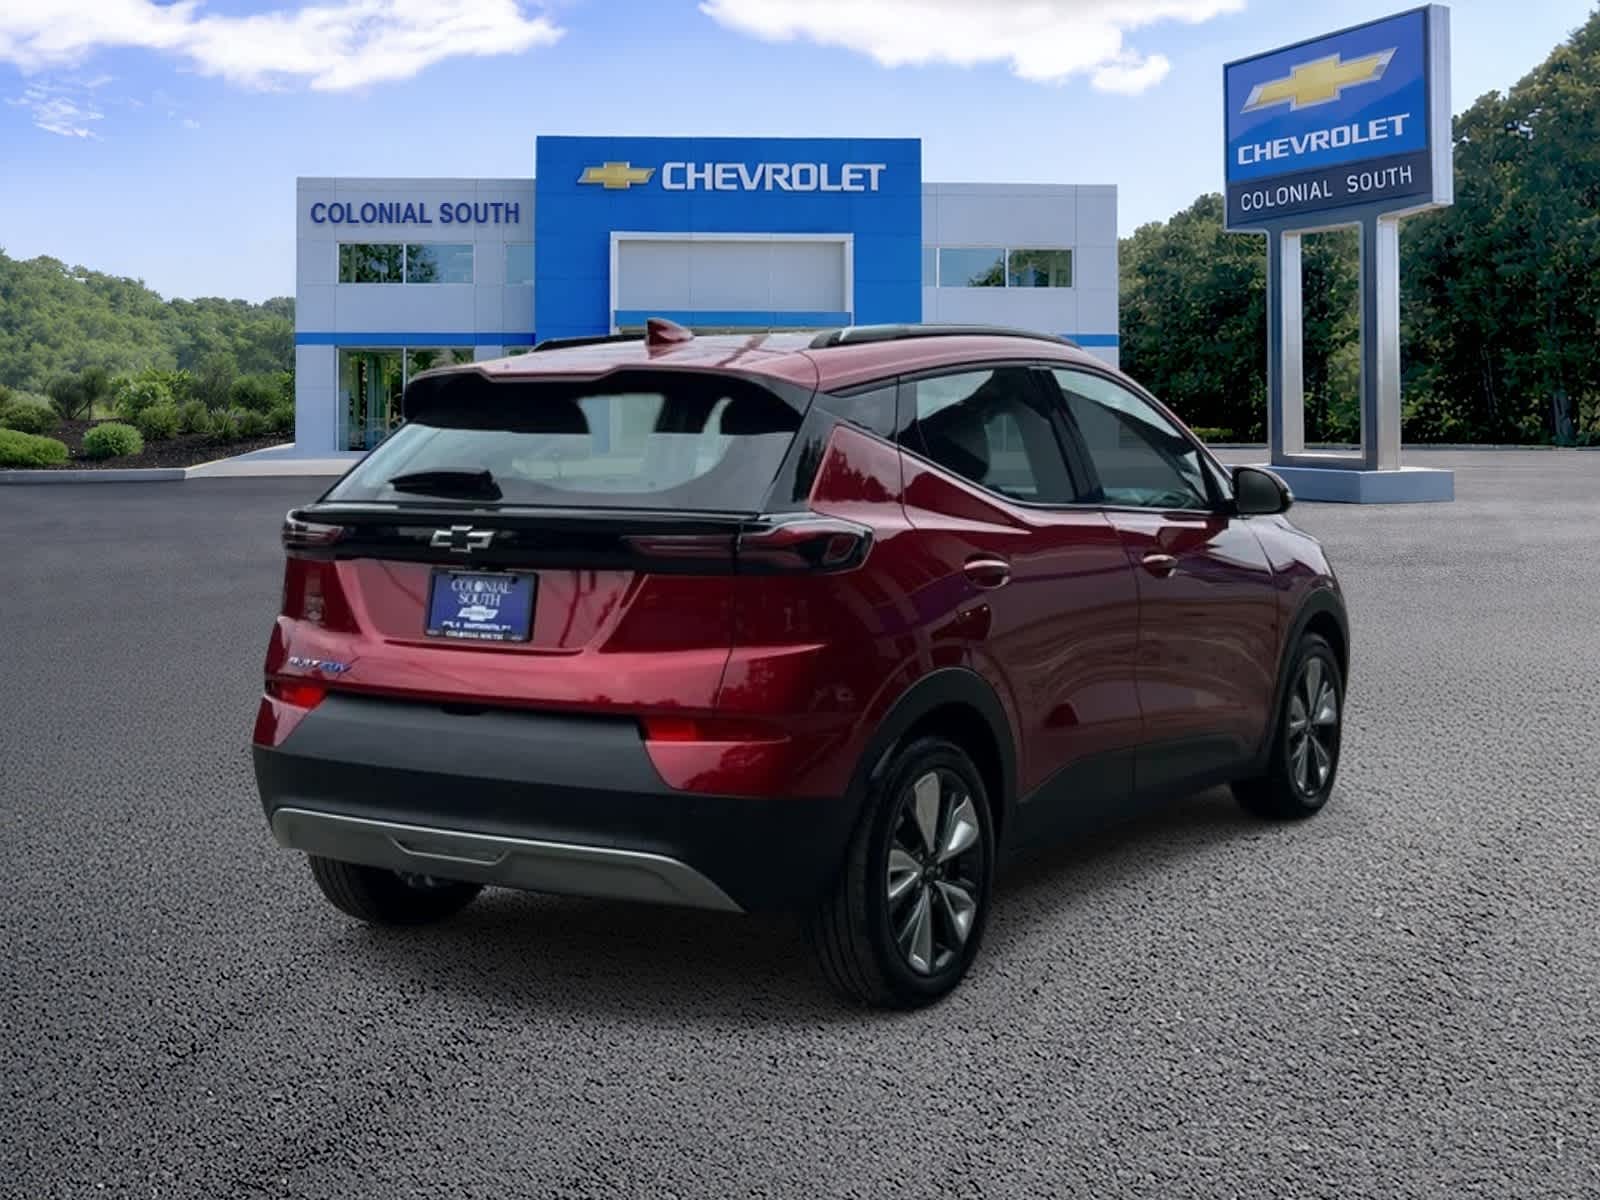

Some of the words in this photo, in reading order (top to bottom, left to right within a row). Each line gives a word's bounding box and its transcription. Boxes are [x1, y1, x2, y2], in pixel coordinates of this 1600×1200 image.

[1237, 114, 1410, 165] CHEVROLET
[661, 162, 886, 192] CHEVROLET
[1240, 180, 1333, 211] COLONIAL
[1346, 165, 1413, 193] SOUTH
[311, 203, 433, 224] COLONIAL
[440, 203, 521, 224] SOUTH
[451, 578, 512, 594] COLONIAL
[457, 592, 500, 606] SOUTH
